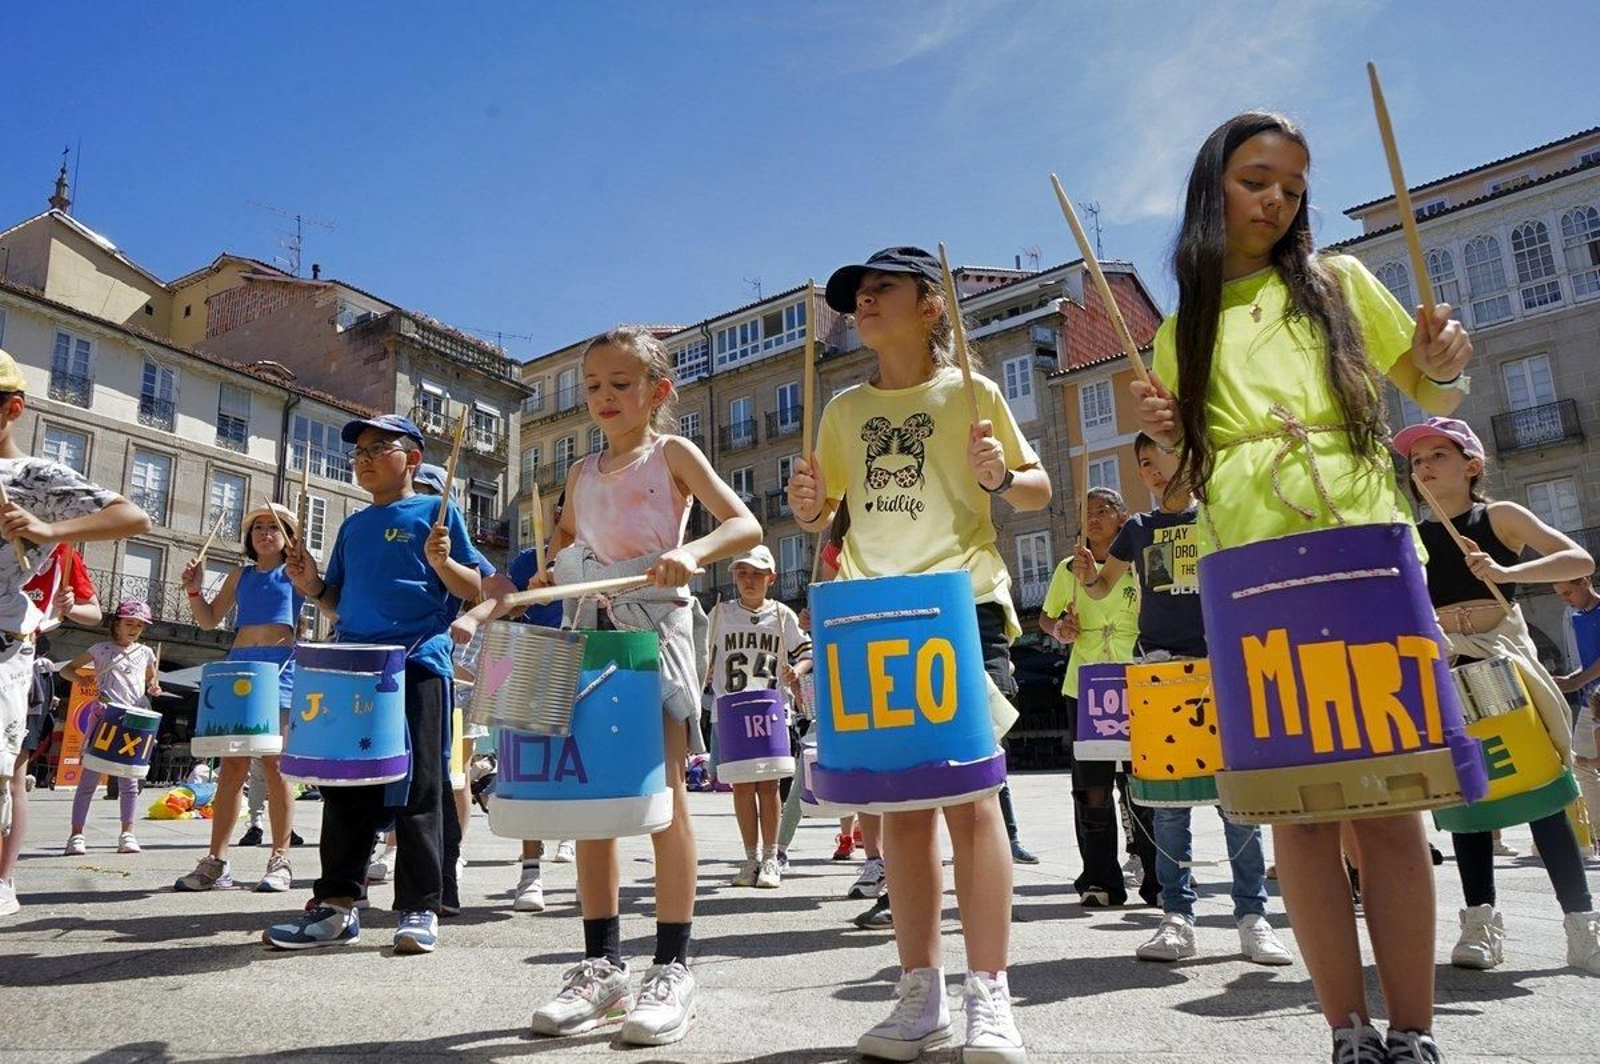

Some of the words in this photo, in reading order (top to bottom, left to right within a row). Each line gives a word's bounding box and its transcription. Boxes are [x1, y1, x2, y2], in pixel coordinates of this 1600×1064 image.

[876, 494, 925, 521] kidlife
[1162, 527, 1189, 543] PLAY
[1181, 564, 1196, 575] THE
[724, 632, 780, 653] MIAMI
[725, 652, 778, 693] 64
[827, 637, 958, 732] LEO
[1241, 628, 1444, 754] MART
